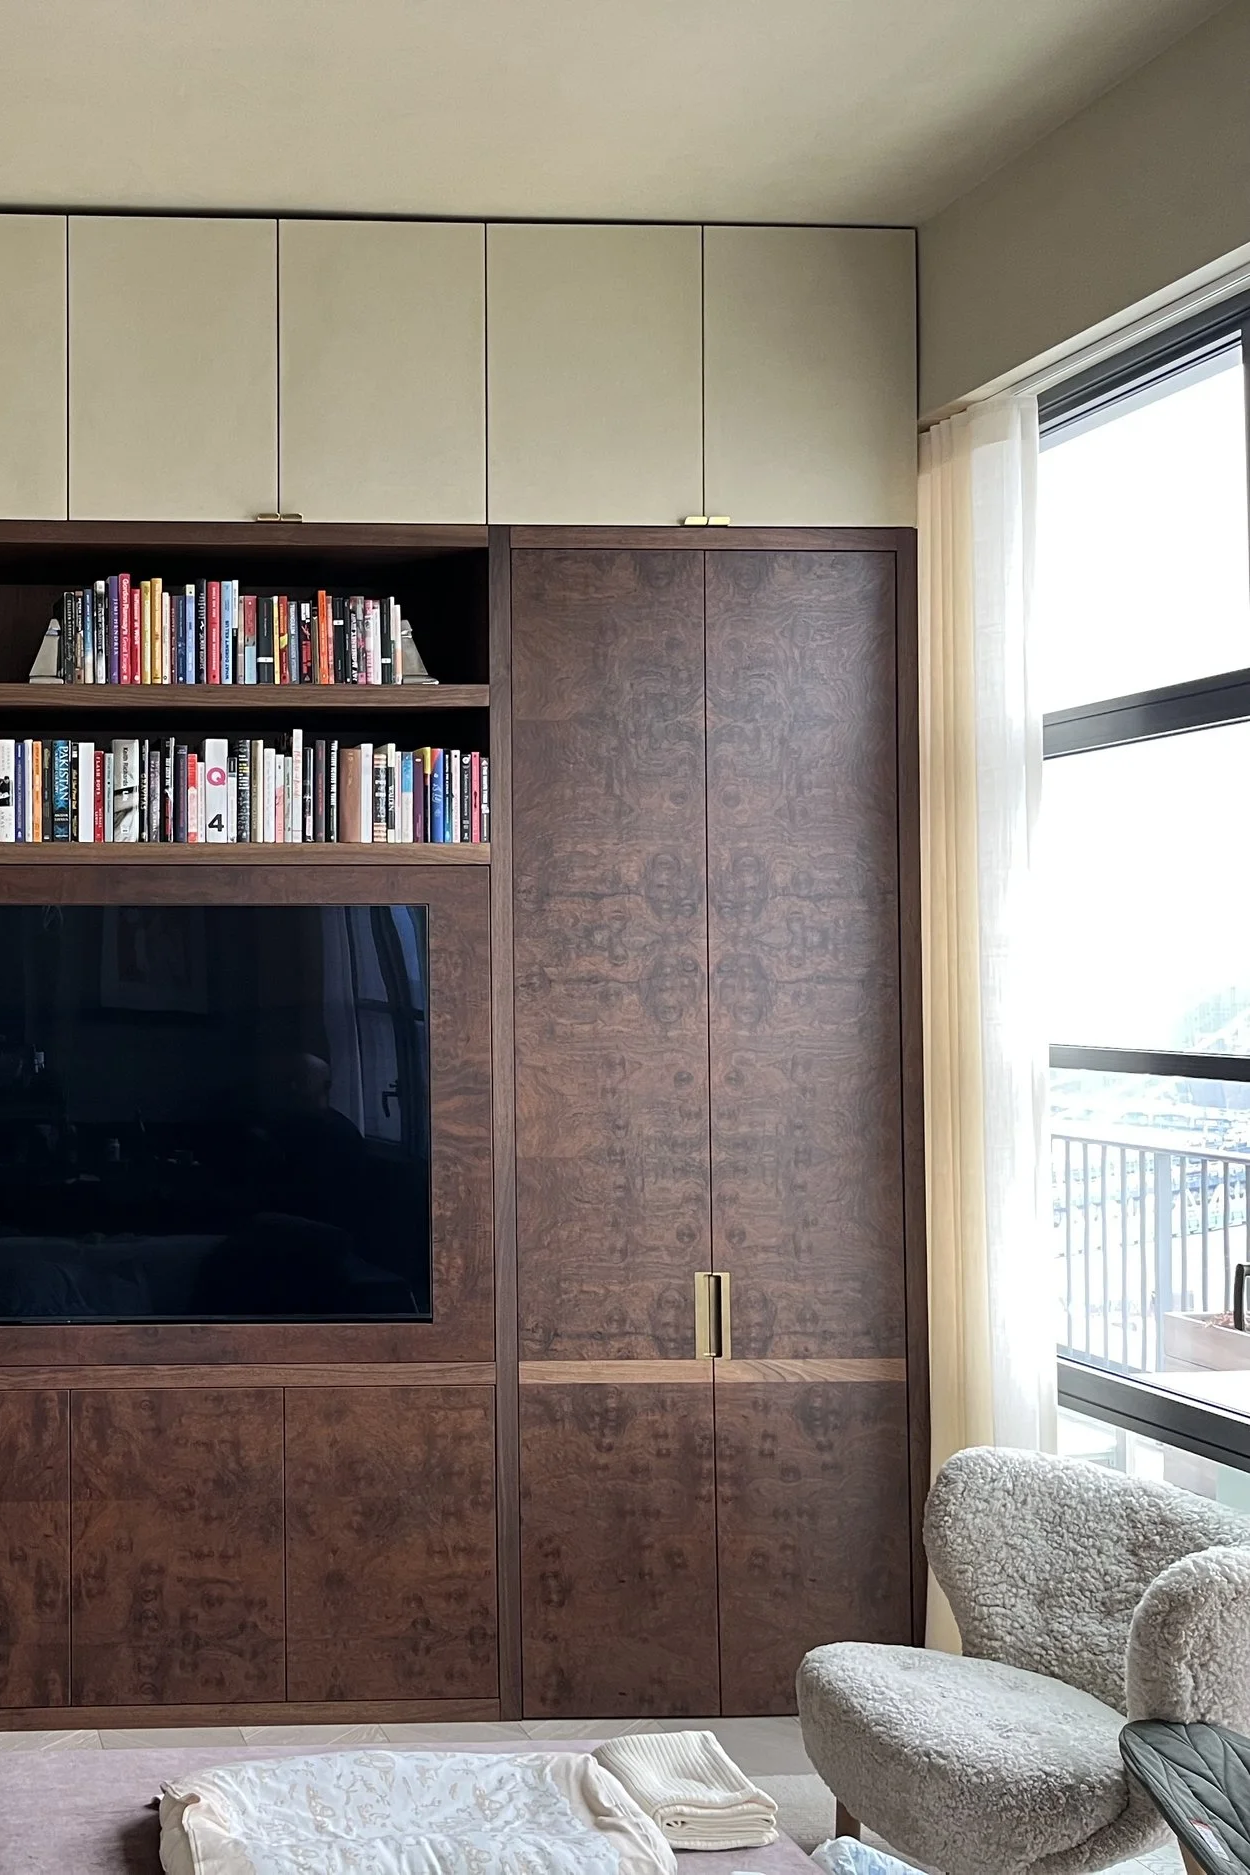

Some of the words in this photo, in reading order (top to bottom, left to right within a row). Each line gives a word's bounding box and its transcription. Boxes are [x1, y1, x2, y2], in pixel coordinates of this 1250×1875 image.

[122, 578, 130, 604] Gordon
[121, 604, 129, 635] Ramsay's
[59, 745, 69, 800] PAKISTAN
[207, 767, 226, 786] Q
[208, 814, 224, 832] 4
